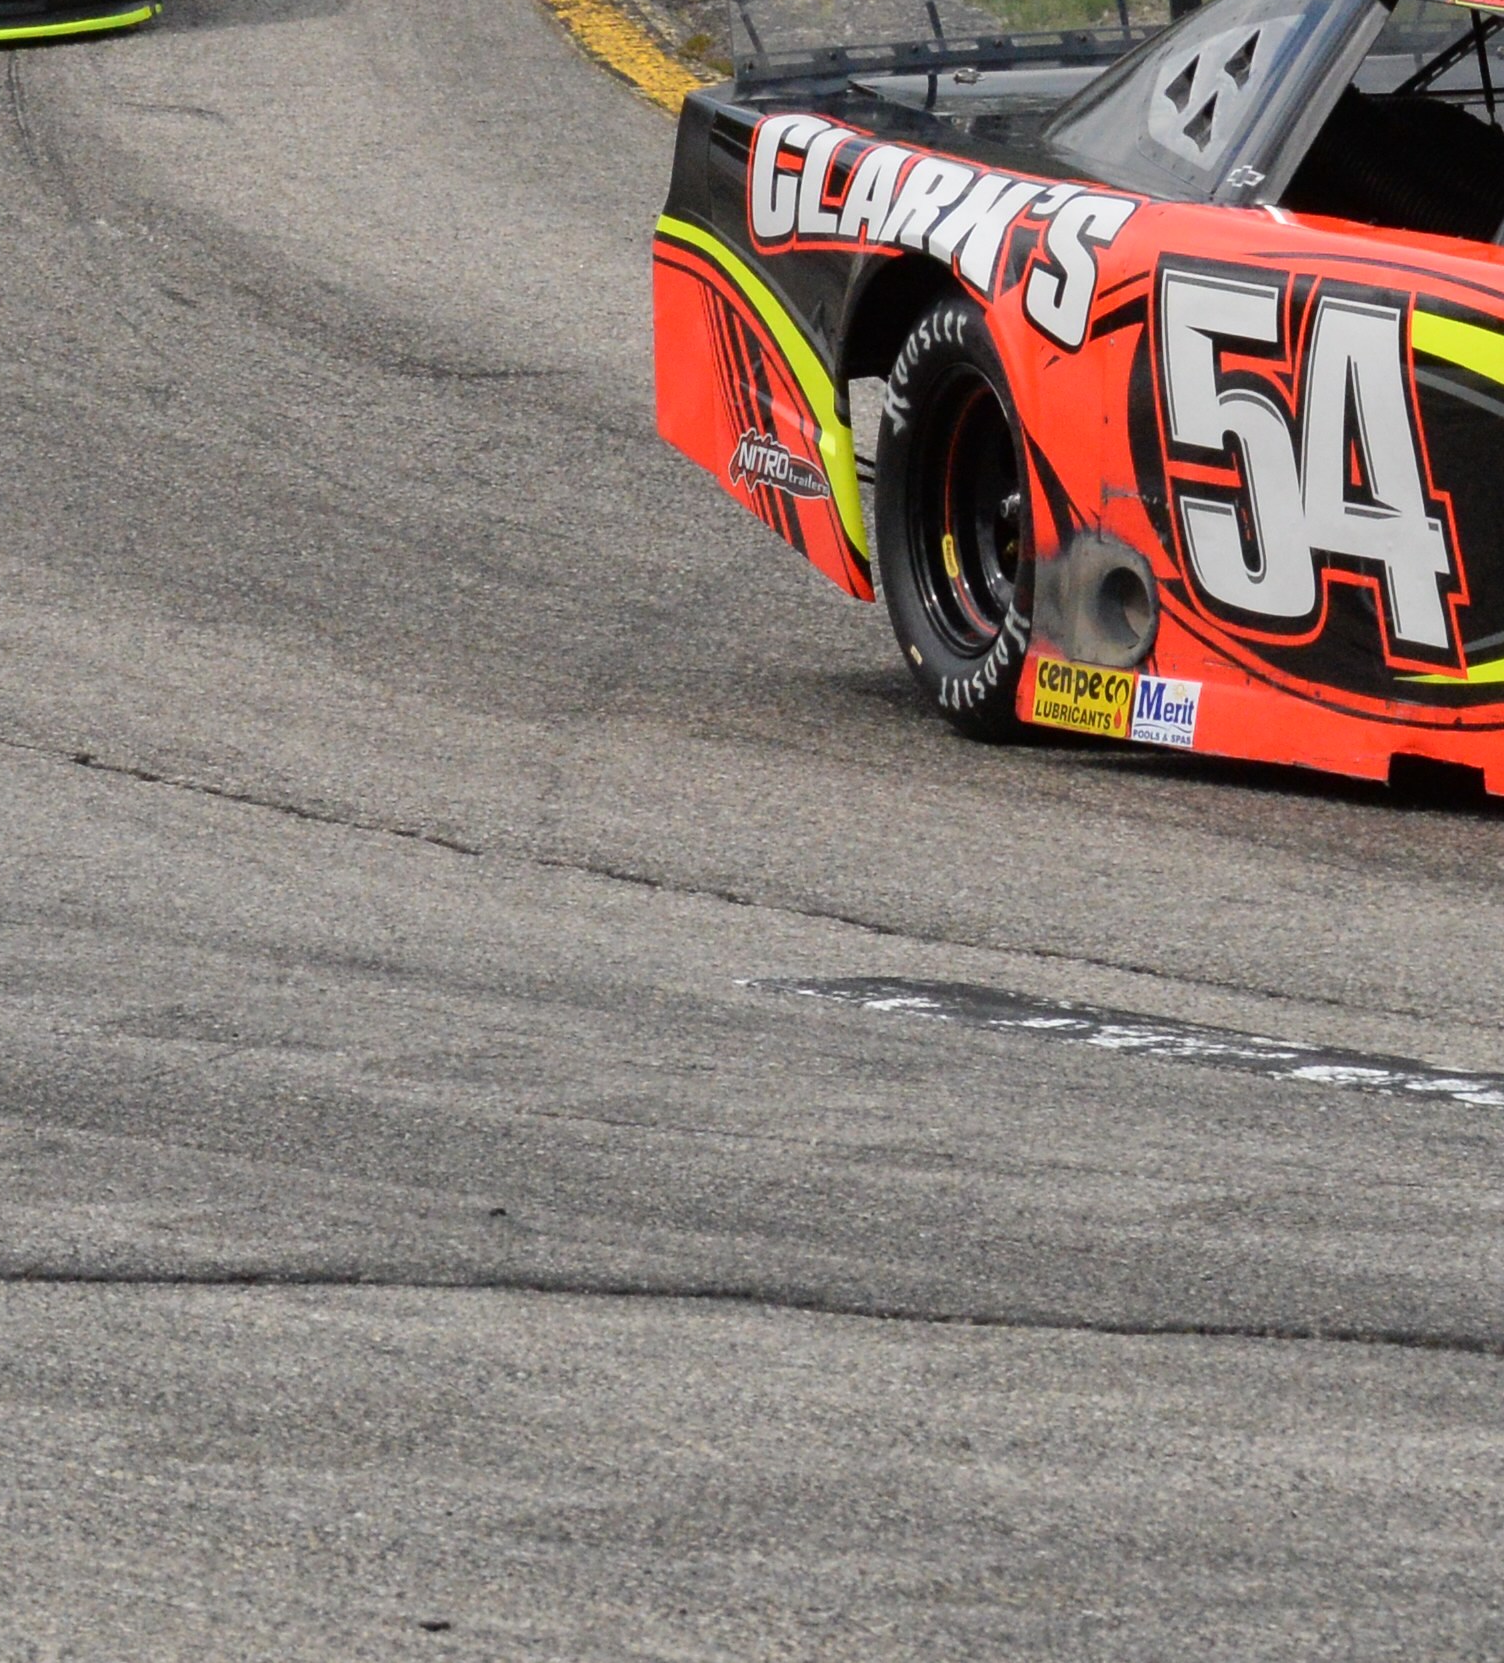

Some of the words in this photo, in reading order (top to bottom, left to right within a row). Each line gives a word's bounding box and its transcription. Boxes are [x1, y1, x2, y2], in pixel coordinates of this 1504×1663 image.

[753, 114, 1136, 347] CLARK'S
[738, 441, 790, 480] NITRO
[789, 467, 829, 495] trailers
[1161, 268, 1450, 649] 54
[1035, 700, 1112, 730] LUBRICANTS
[1137, 680, 1194, 725] Merit
[1133, 729, 1160, 741] POOLS
[1170, 733, 1191, 745] SPAS
